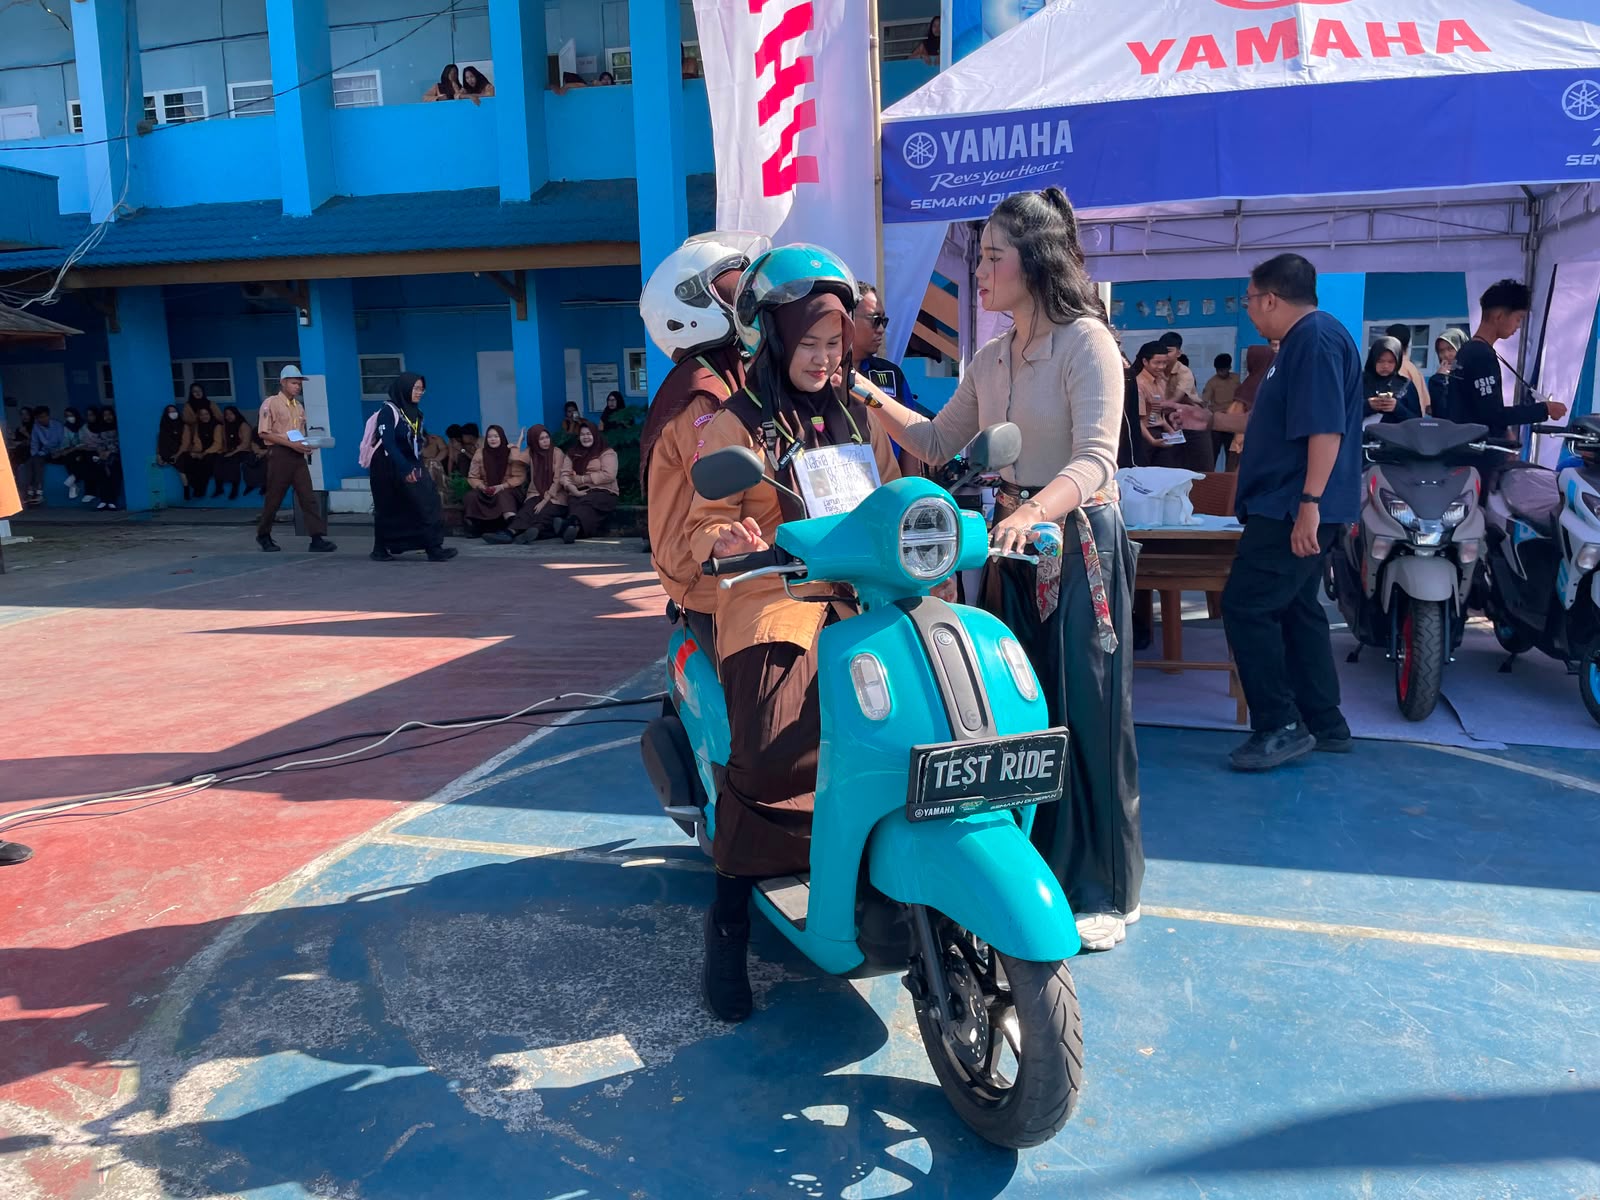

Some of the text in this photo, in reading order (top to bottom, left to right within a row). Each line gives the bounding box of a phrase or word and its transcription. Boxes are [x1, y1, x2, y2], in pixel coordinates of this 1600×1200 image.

[1126, 17, 1492, 75] YAMAHA
[940, 119, 1074, 165] YAMAHA
[929, 171, 980, 192] Revs
[981, 168, 1018, 187] Your
[933, 749, 1056, 789] TEST RIDE
[923, 805, 955, 816] YAMAHA
